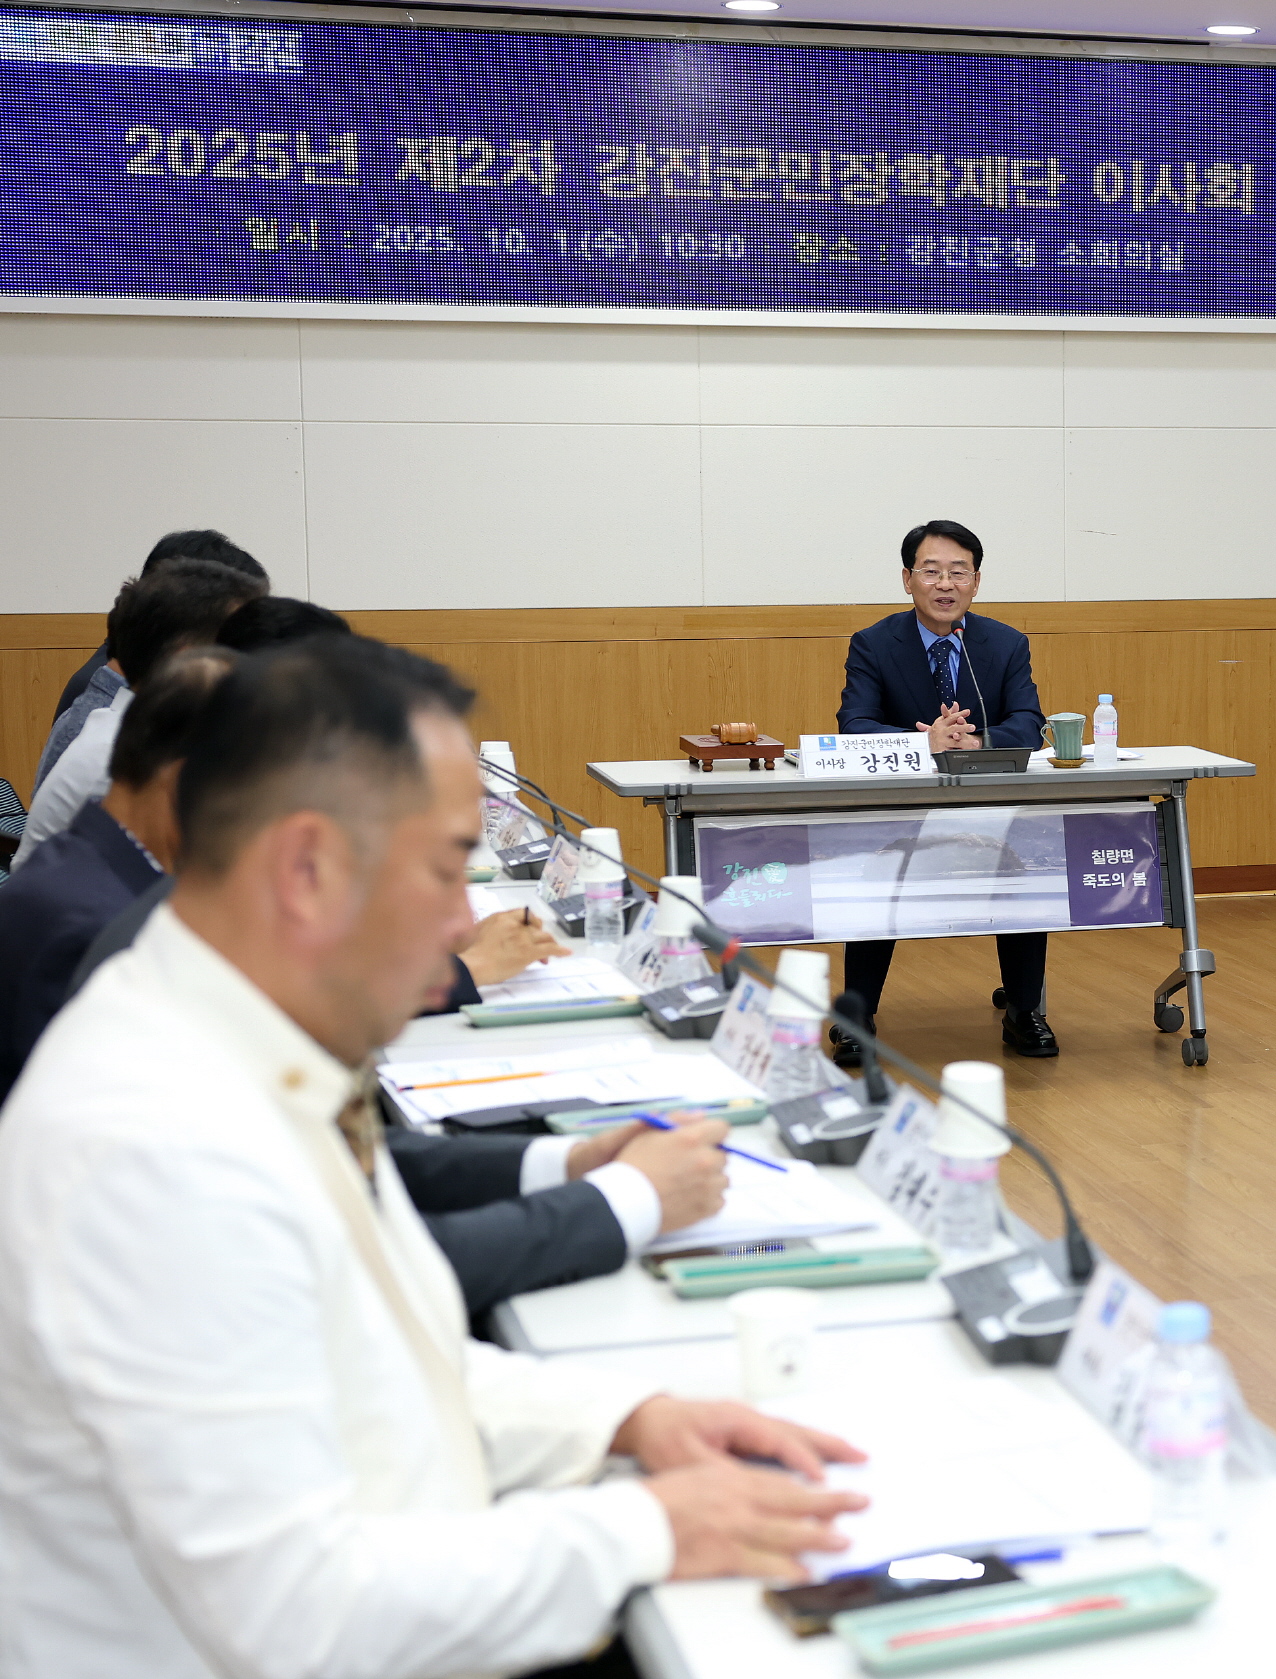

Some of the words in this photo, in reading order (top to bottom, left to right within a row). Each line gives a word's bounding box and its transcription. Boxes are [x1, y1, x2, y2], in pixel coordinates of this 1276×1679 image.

[124, 124, 360, 187] 2025년
[396, 136, 561, 195] 제2차
[599, 143, 1068, 209] 강진군민장학재단
[1093, 159, 1255, 214] 이사회
[245, 217, 319, 252] 일시
[373, 224, 463, 252] 2025.
[485, 227, 533, 254] 10.
[661, 231, 746, 260] 10:30
[792, 232, 860, 264] 장소
[907, 235, 1037, 269] 강진군청
[1057, 239, 1185, 272] 소회의실
[841, 738, 911, 750] 강진군민장학재단
[815, 757, 847, 770] 이사장
[860, 751, 921, 774] 강진원
[1091, 849, 1134, 865] 칠량면
[722, 862, 763, 886] 강진
[1082, 872, 1125, 888] 죽도의
[1132, 871, 1147, 887] 봄
